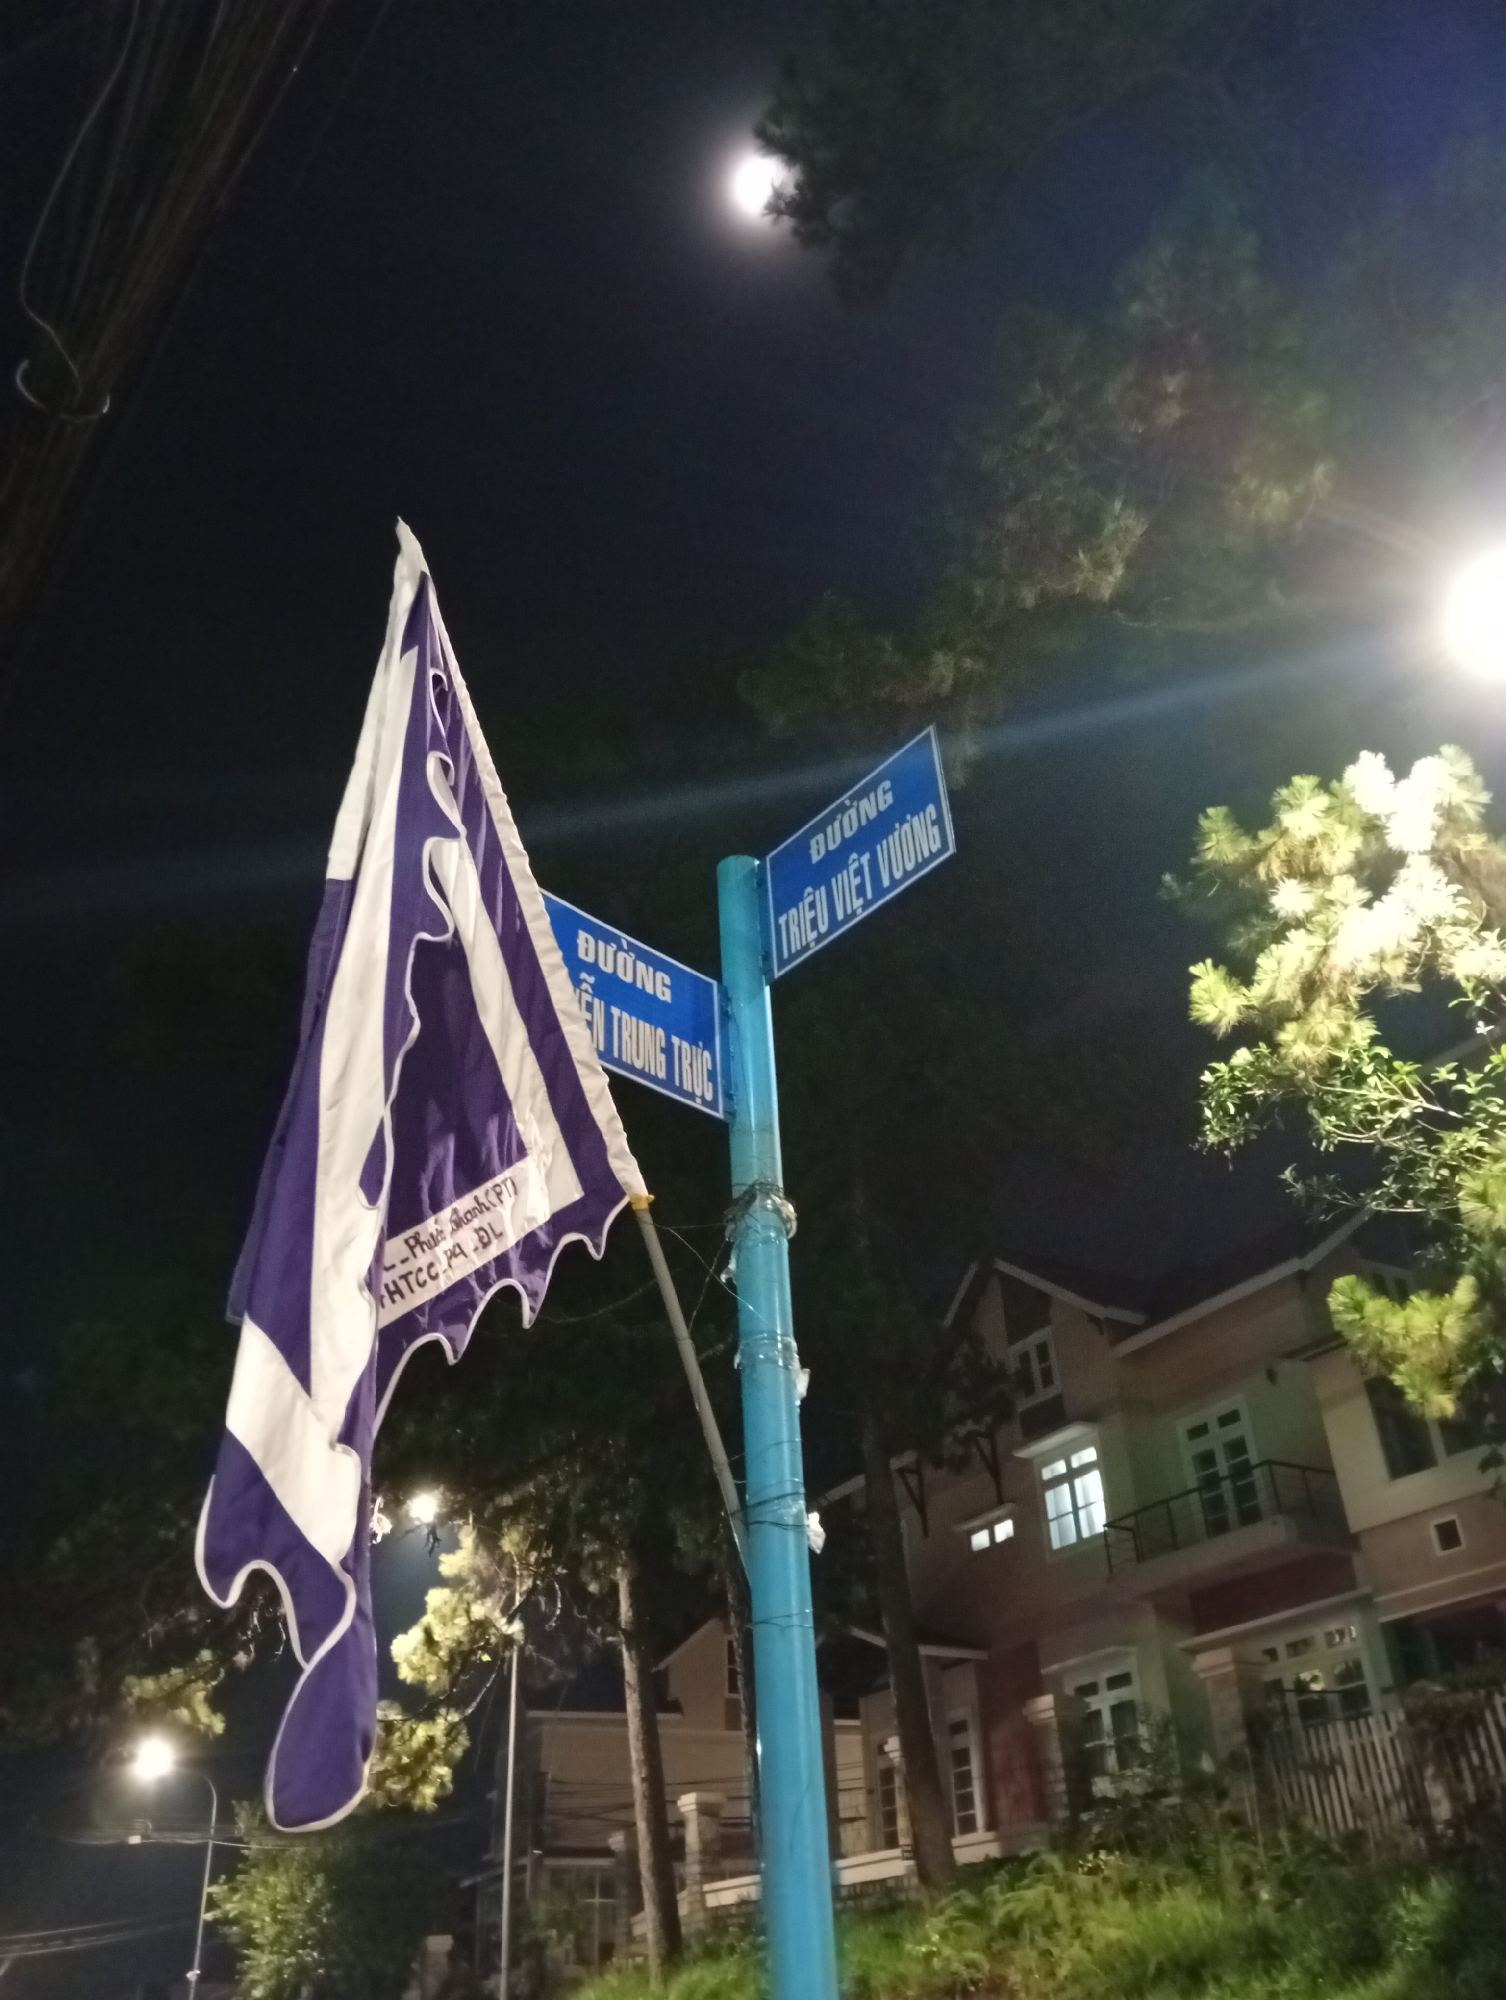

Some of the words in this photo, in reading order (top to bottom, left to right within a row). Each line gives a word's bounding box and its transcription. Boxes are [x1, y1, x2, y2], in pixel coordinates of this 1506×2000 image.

[809, 780, 894, 865] ĐƯỜNG
[778, 886, 829, 960] TRIỆU
[831, 852, 873, 922] VIỆT
[876, 803, 942, 889] VƯƠNG
[576, 929, 672, 1003] ĐƯỜNG
[576, 972, 605, 1052] ỄN
[610, 1005, 667, 1080] TRUNG
[671, 1034, 713, 1104] TRỰC
